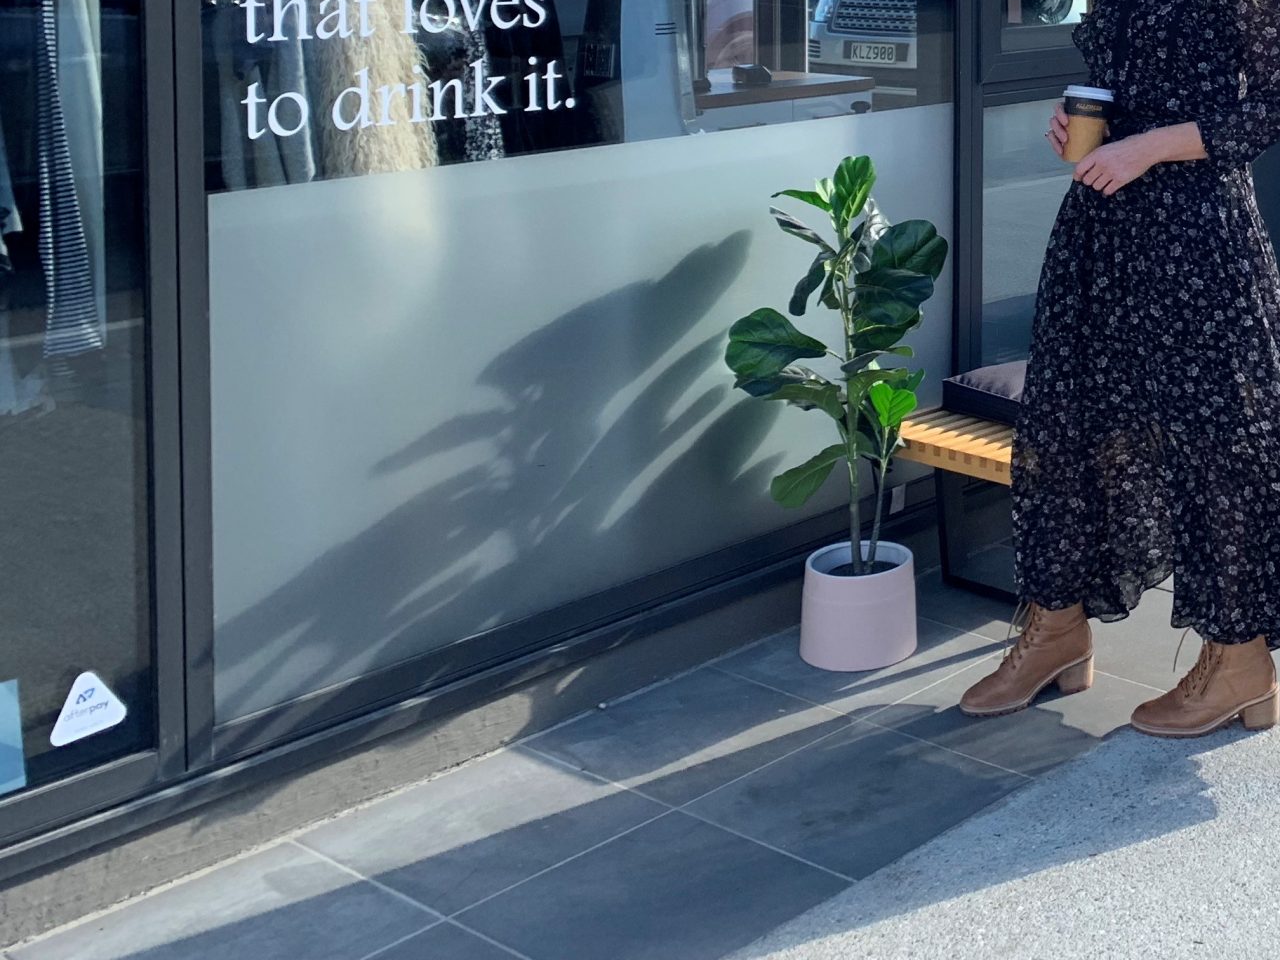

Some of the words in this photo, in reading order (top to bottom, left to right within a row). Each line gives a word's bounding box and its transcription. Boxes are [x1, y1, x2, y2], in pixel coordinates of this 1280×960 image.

[852, 45, 894, 60] KLZ900
[240, 82, 309, 140] to
[331, 60, 508, 131] drink
[523, 55, 576, 113] it.
[63, 700, 109, 722] afterpay
